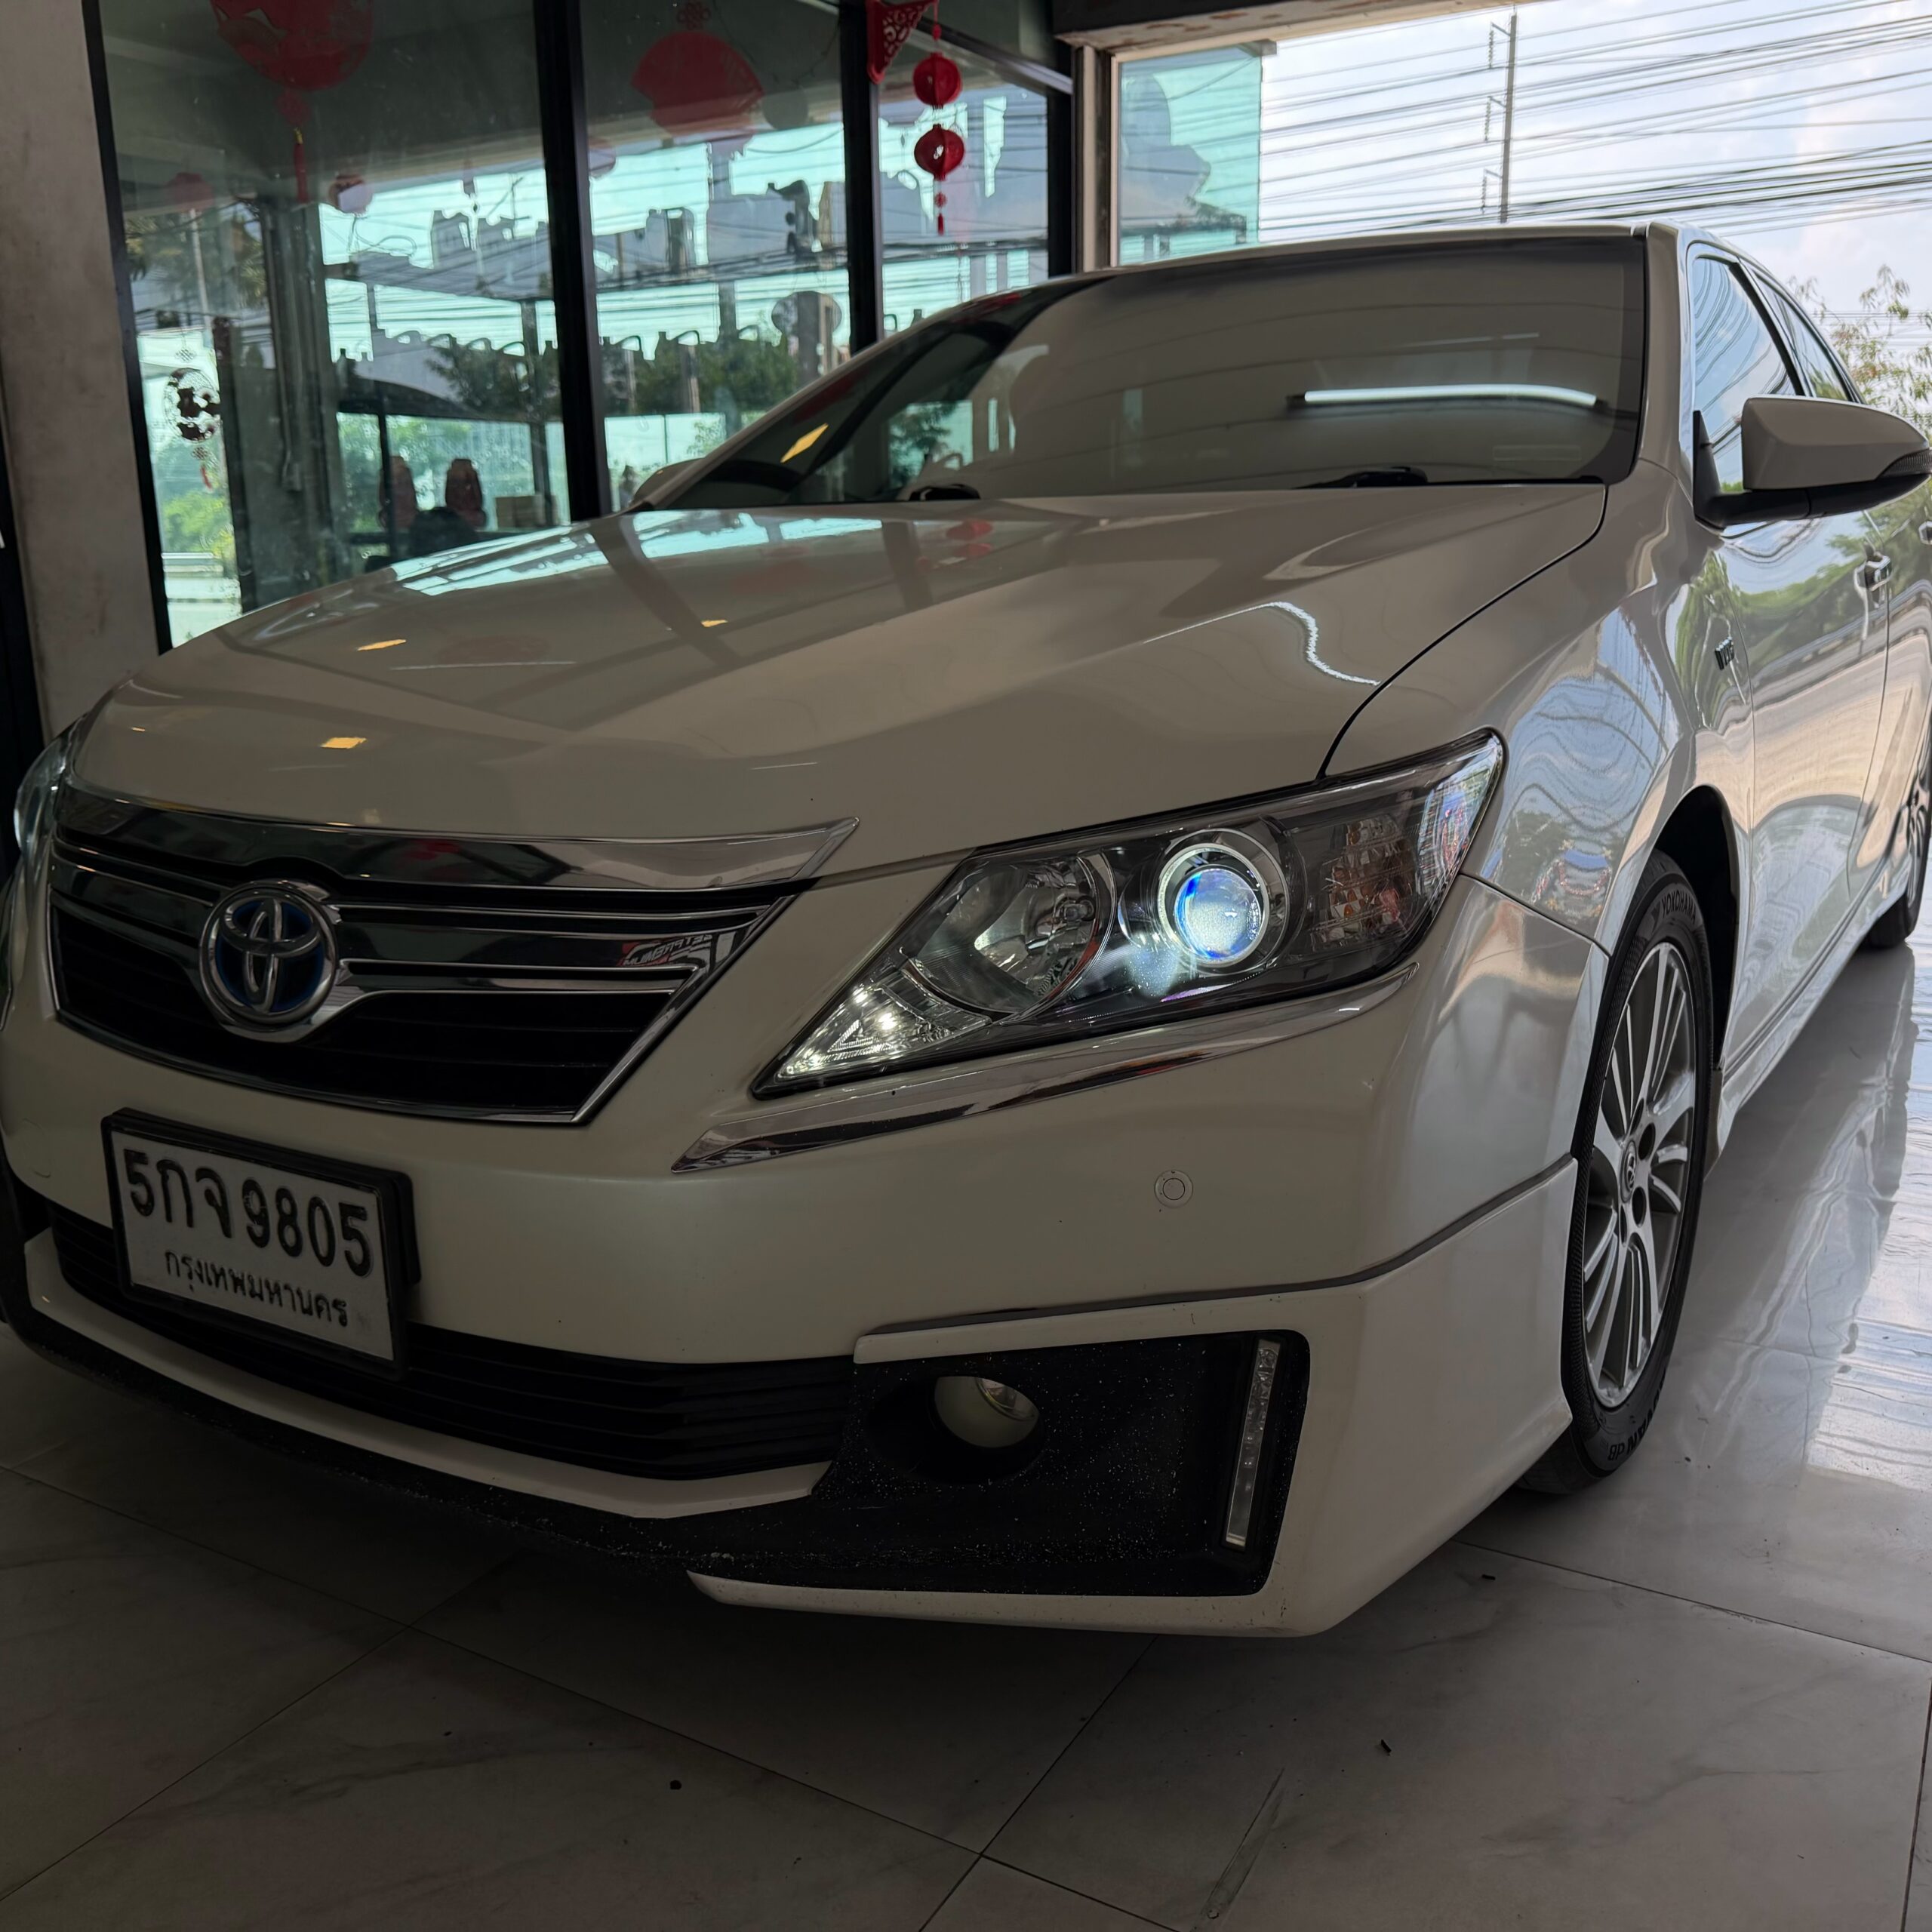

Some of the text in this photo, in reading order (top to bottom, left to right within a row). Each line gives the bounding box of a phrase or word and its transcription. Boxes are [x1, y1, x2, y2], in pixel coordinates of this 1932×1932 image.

[1661, 890, 1697, 925] YOKOHAMA
[164, 1249, 349, 1327] กรุงเทพมหานคร
